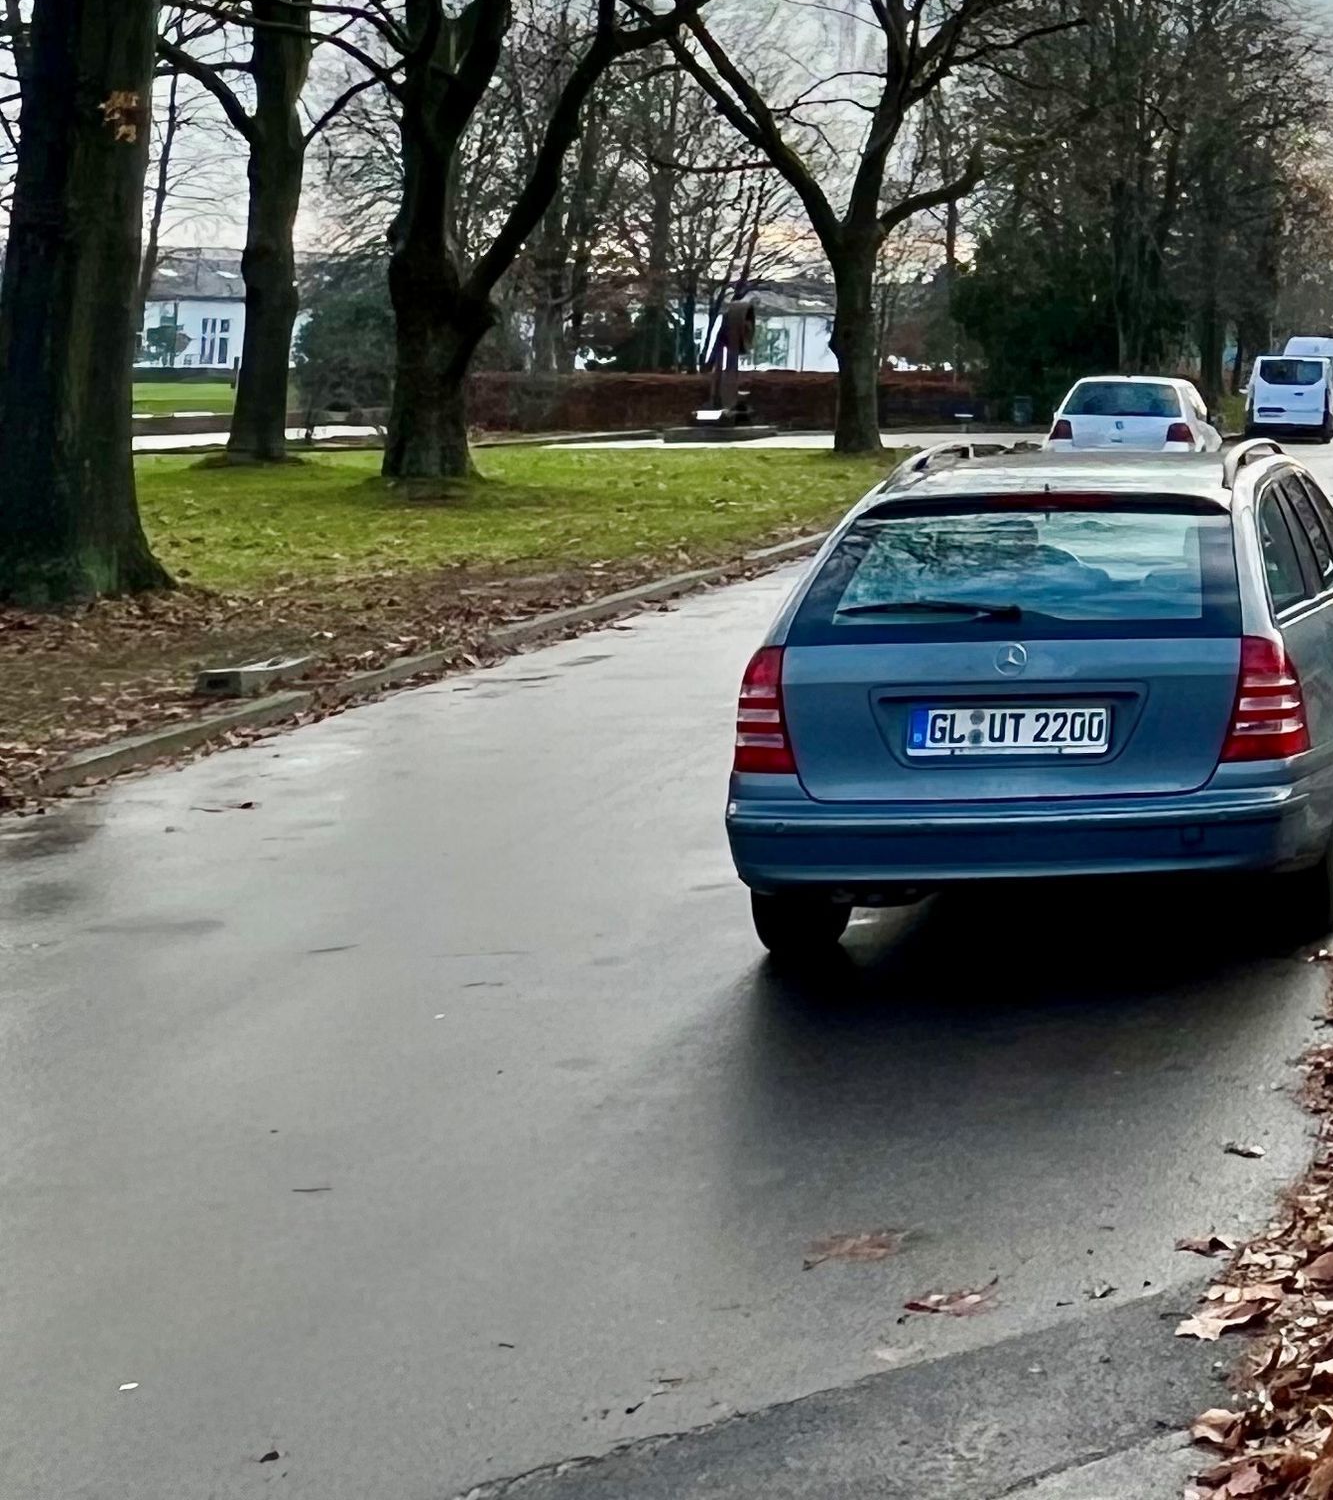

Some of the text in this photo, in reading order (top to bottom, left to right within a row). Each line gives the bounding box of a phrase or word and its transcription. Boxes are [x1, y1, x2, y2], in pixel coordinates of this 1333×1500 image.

[929, 712, 1104, 744] GL UT 2200
